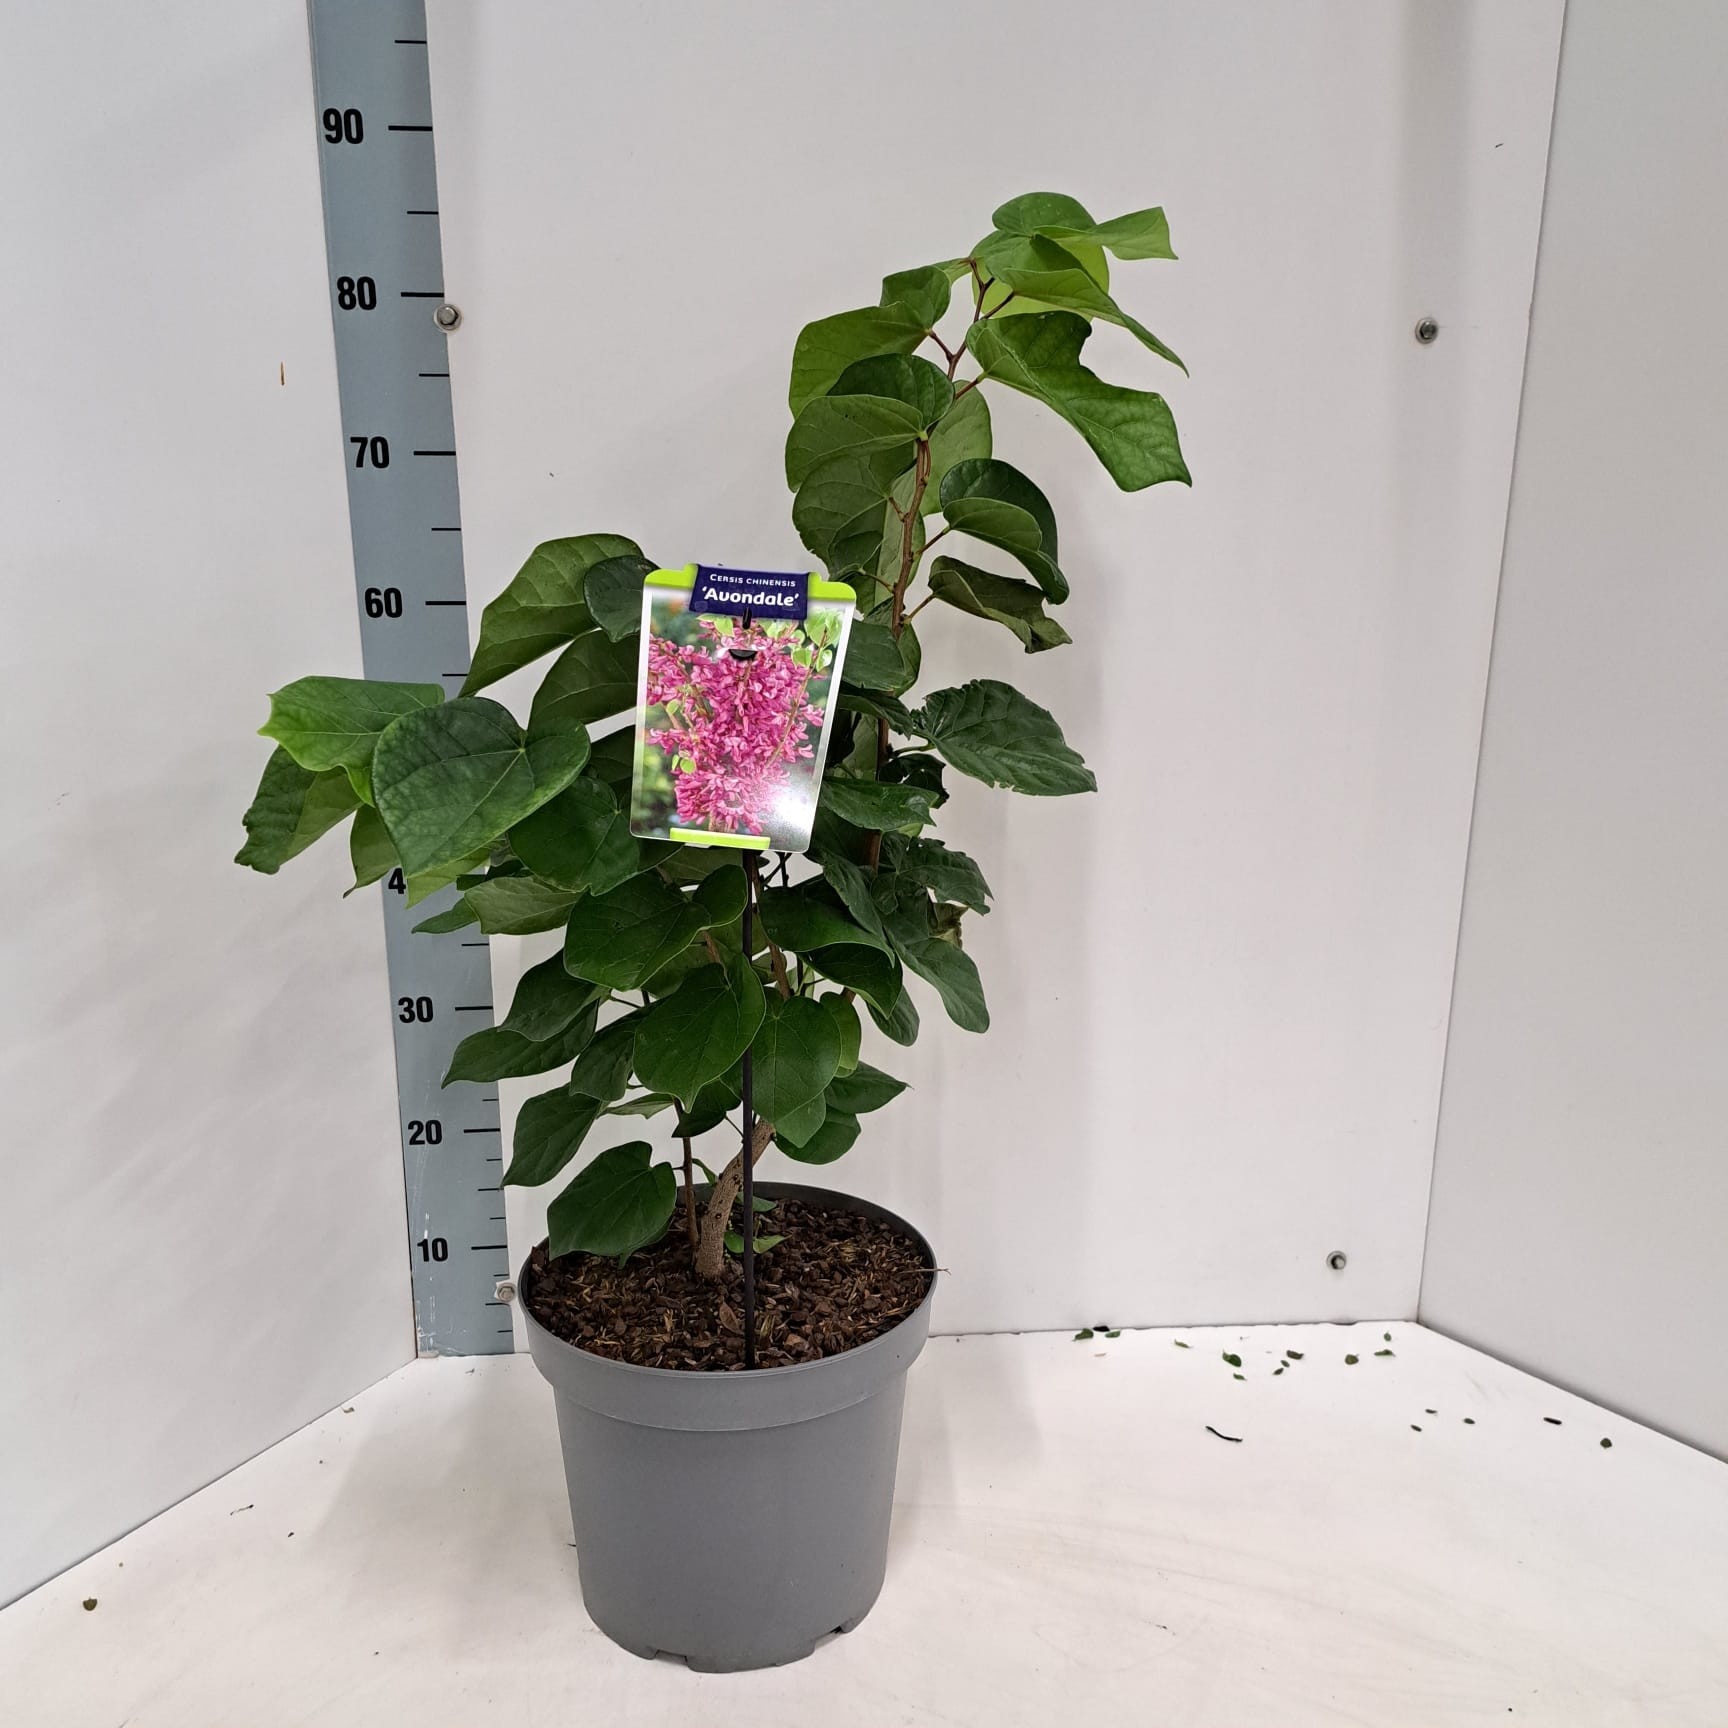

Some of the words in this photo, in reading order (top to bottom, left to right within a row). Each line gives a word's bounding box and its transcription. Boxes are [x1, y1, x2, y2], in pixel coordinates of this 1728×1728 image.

[323, 108, 363, 144] 90
[337, 276, 377, 310] 80
[350, 437, 389, 468] 70
[364, 588, 402, 618] 60
[388, 867, 407, 894] 4
[398, 997, 434, 1023] 30
[408, 1120, 442, 1145] 20
[417, 1238, 448, 1262] 10
